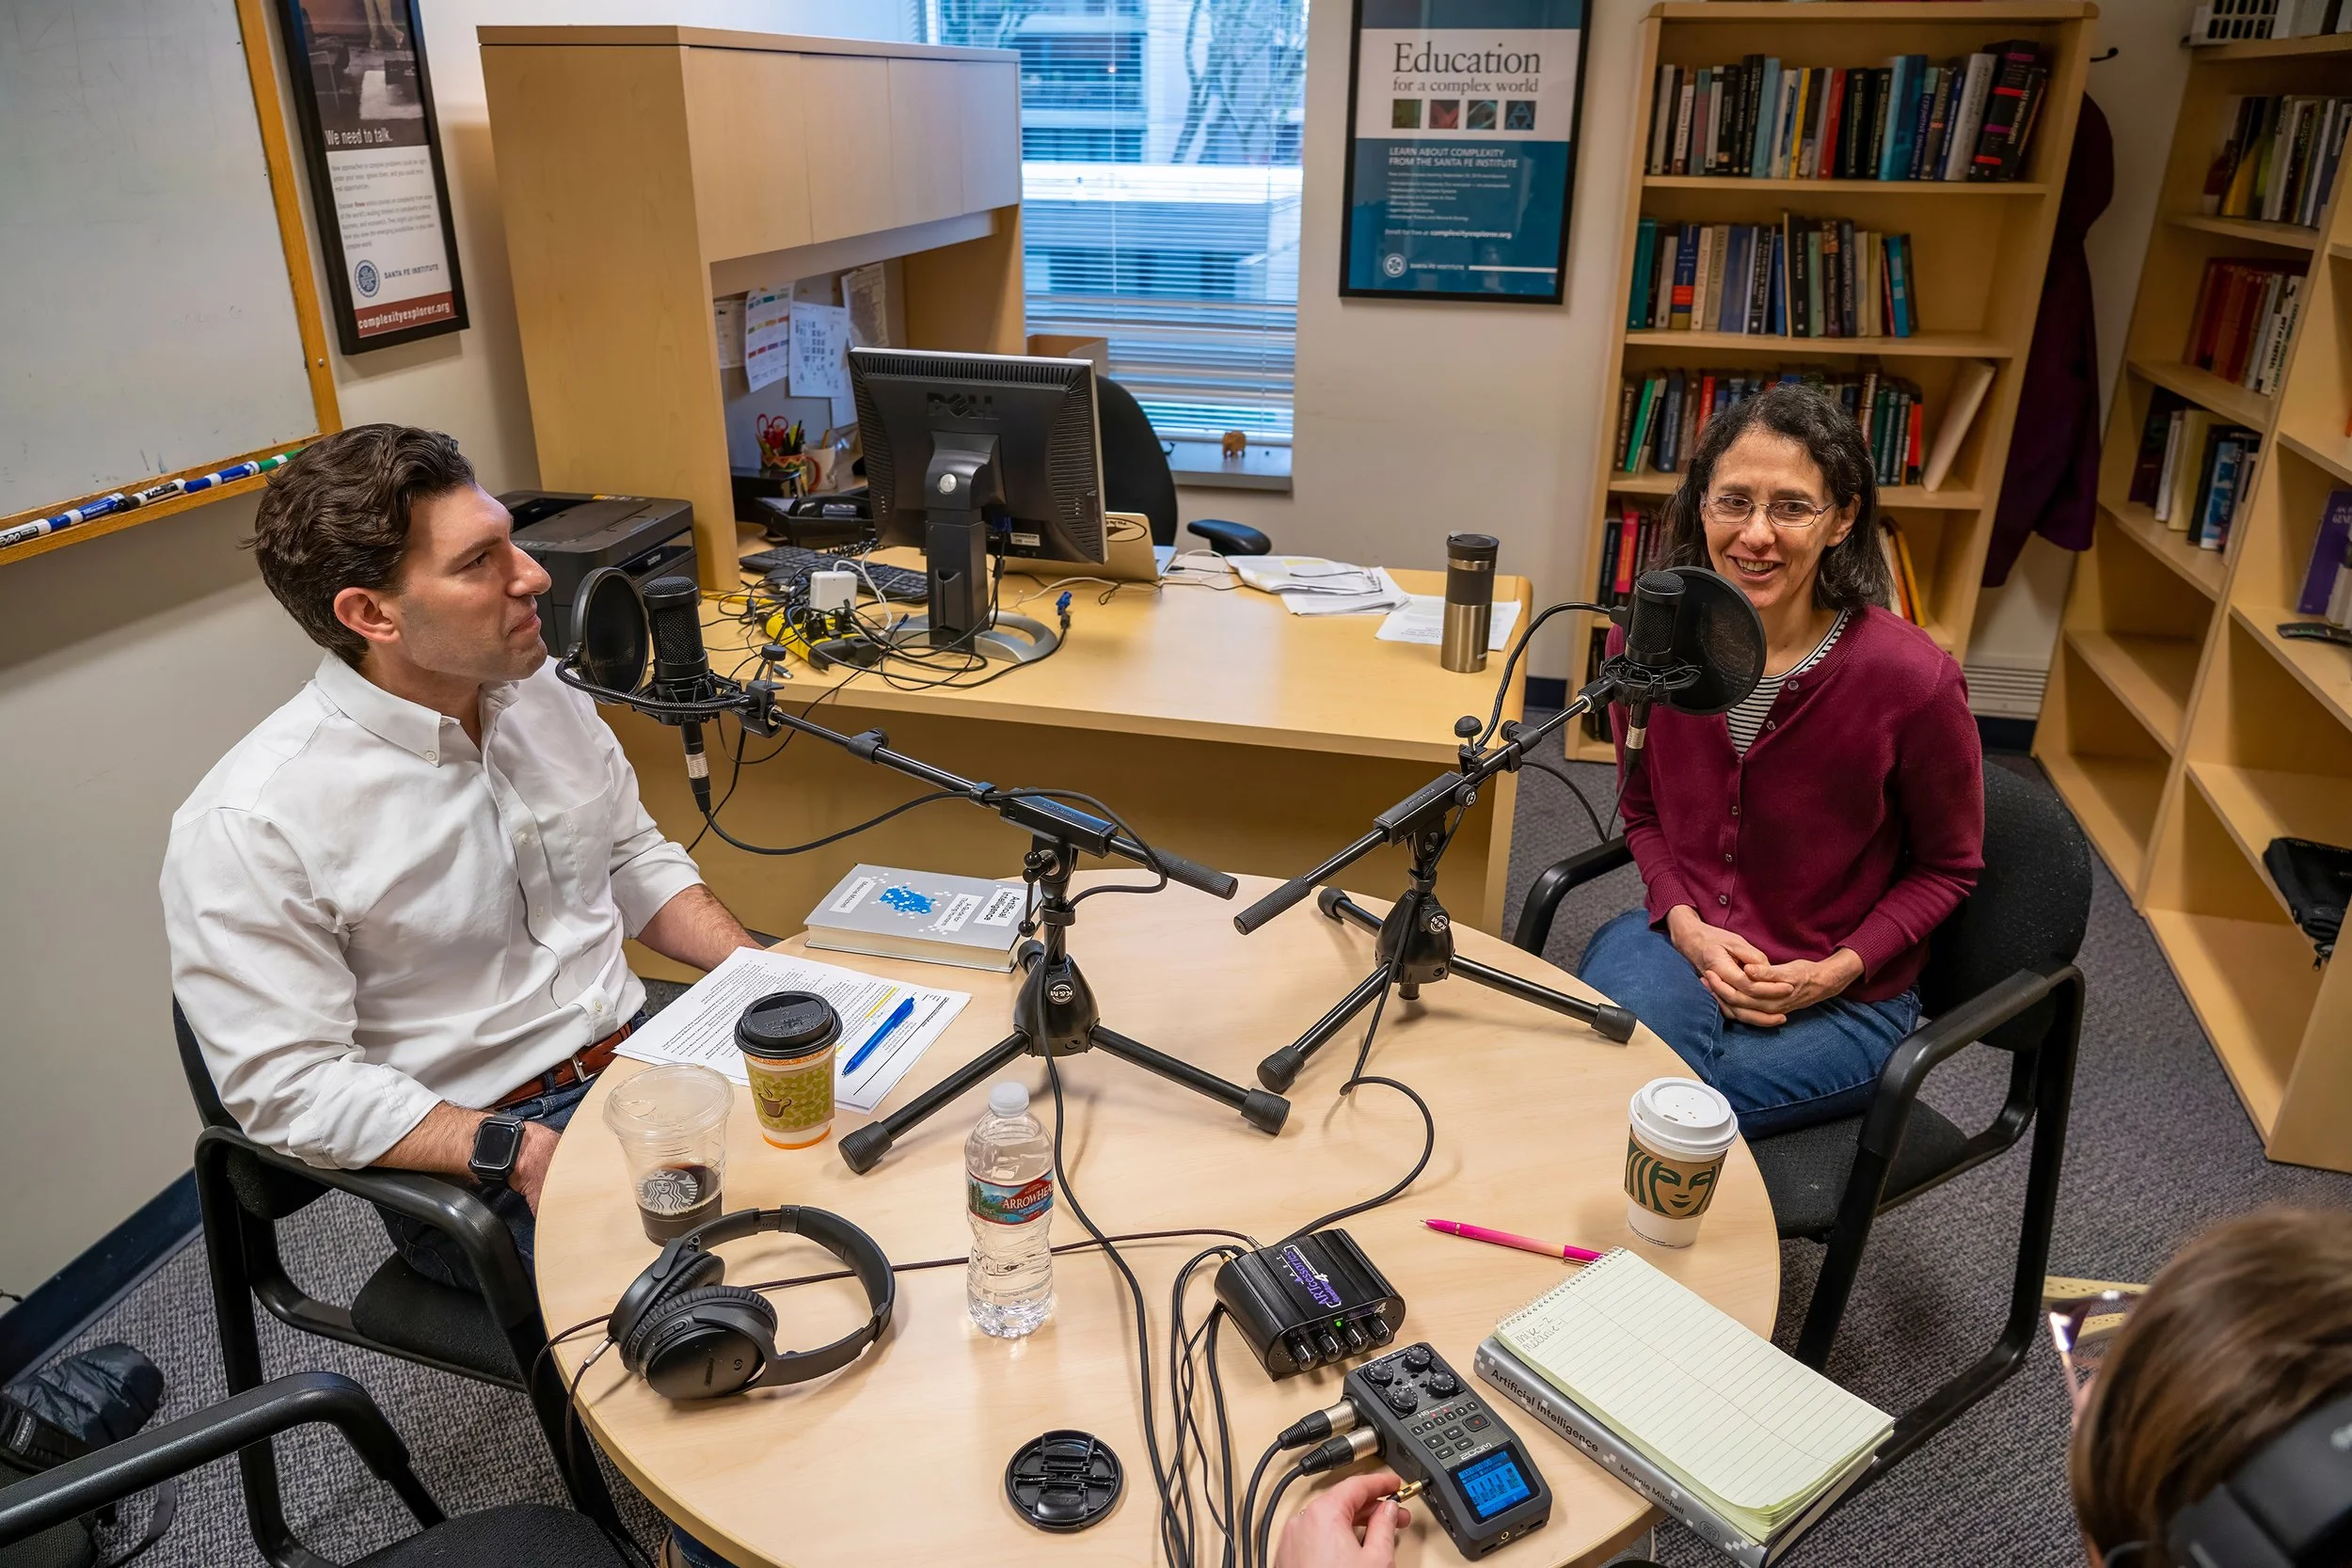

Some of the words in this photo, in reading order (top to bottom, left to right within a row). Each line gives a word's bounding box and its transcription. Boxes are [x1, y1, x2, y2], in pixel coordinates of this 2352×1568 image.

[1392, 40, 1541, 74] Education
[1392, 76, 1414, 92] for
[1417, 82, 1426, 91] a
[1430, 77, 1491, 95] complex
[1496, 77, 1539, 92] world
[325, 130, 340, 146] We
[342, 128, 362, 144] need
[363, 129, 373, 143] to
[1389, 147, 1417, 156] LEARN
[1418, 148, 1449, 157] ABOUT
[1450, 149, 1505, 157] COMPLEXITY
[1389, 157, 1414, 166] FROM
[1416, 157, 1433, 166] THE
[1434, 158, 1462, 166] SANTA
[1464, 159, 1473, 167] FE
[1475, 159, 1518, 168] INSTITUTE
[384, 270, 402, 279] SANTA
[412, 263, 439, 275] INSTITUTE
[358, 302, 451, 329] complexityexplorer.org
[927, 391, 999, 420] DELL
[983, 891, 1013, 921] Intelligence
[997, 895, 1020, 919] Artificial
[1003, 1180, 1053, 1210] ARROWHEA
[1285, 1249, 1328, 1305] ARTcessories
[1374, 1302, 1387, 1314] 4
[1490, 1369, 1535, 1406] Artificial
[1537, 1402, 1598, 1452] Intelligence
[1459, 1442, 1493, 1461] ZOOM
[1620, 1464, 1650, 1491] Melanie
[1651, 1486, 1684, 1515] Mitchell
